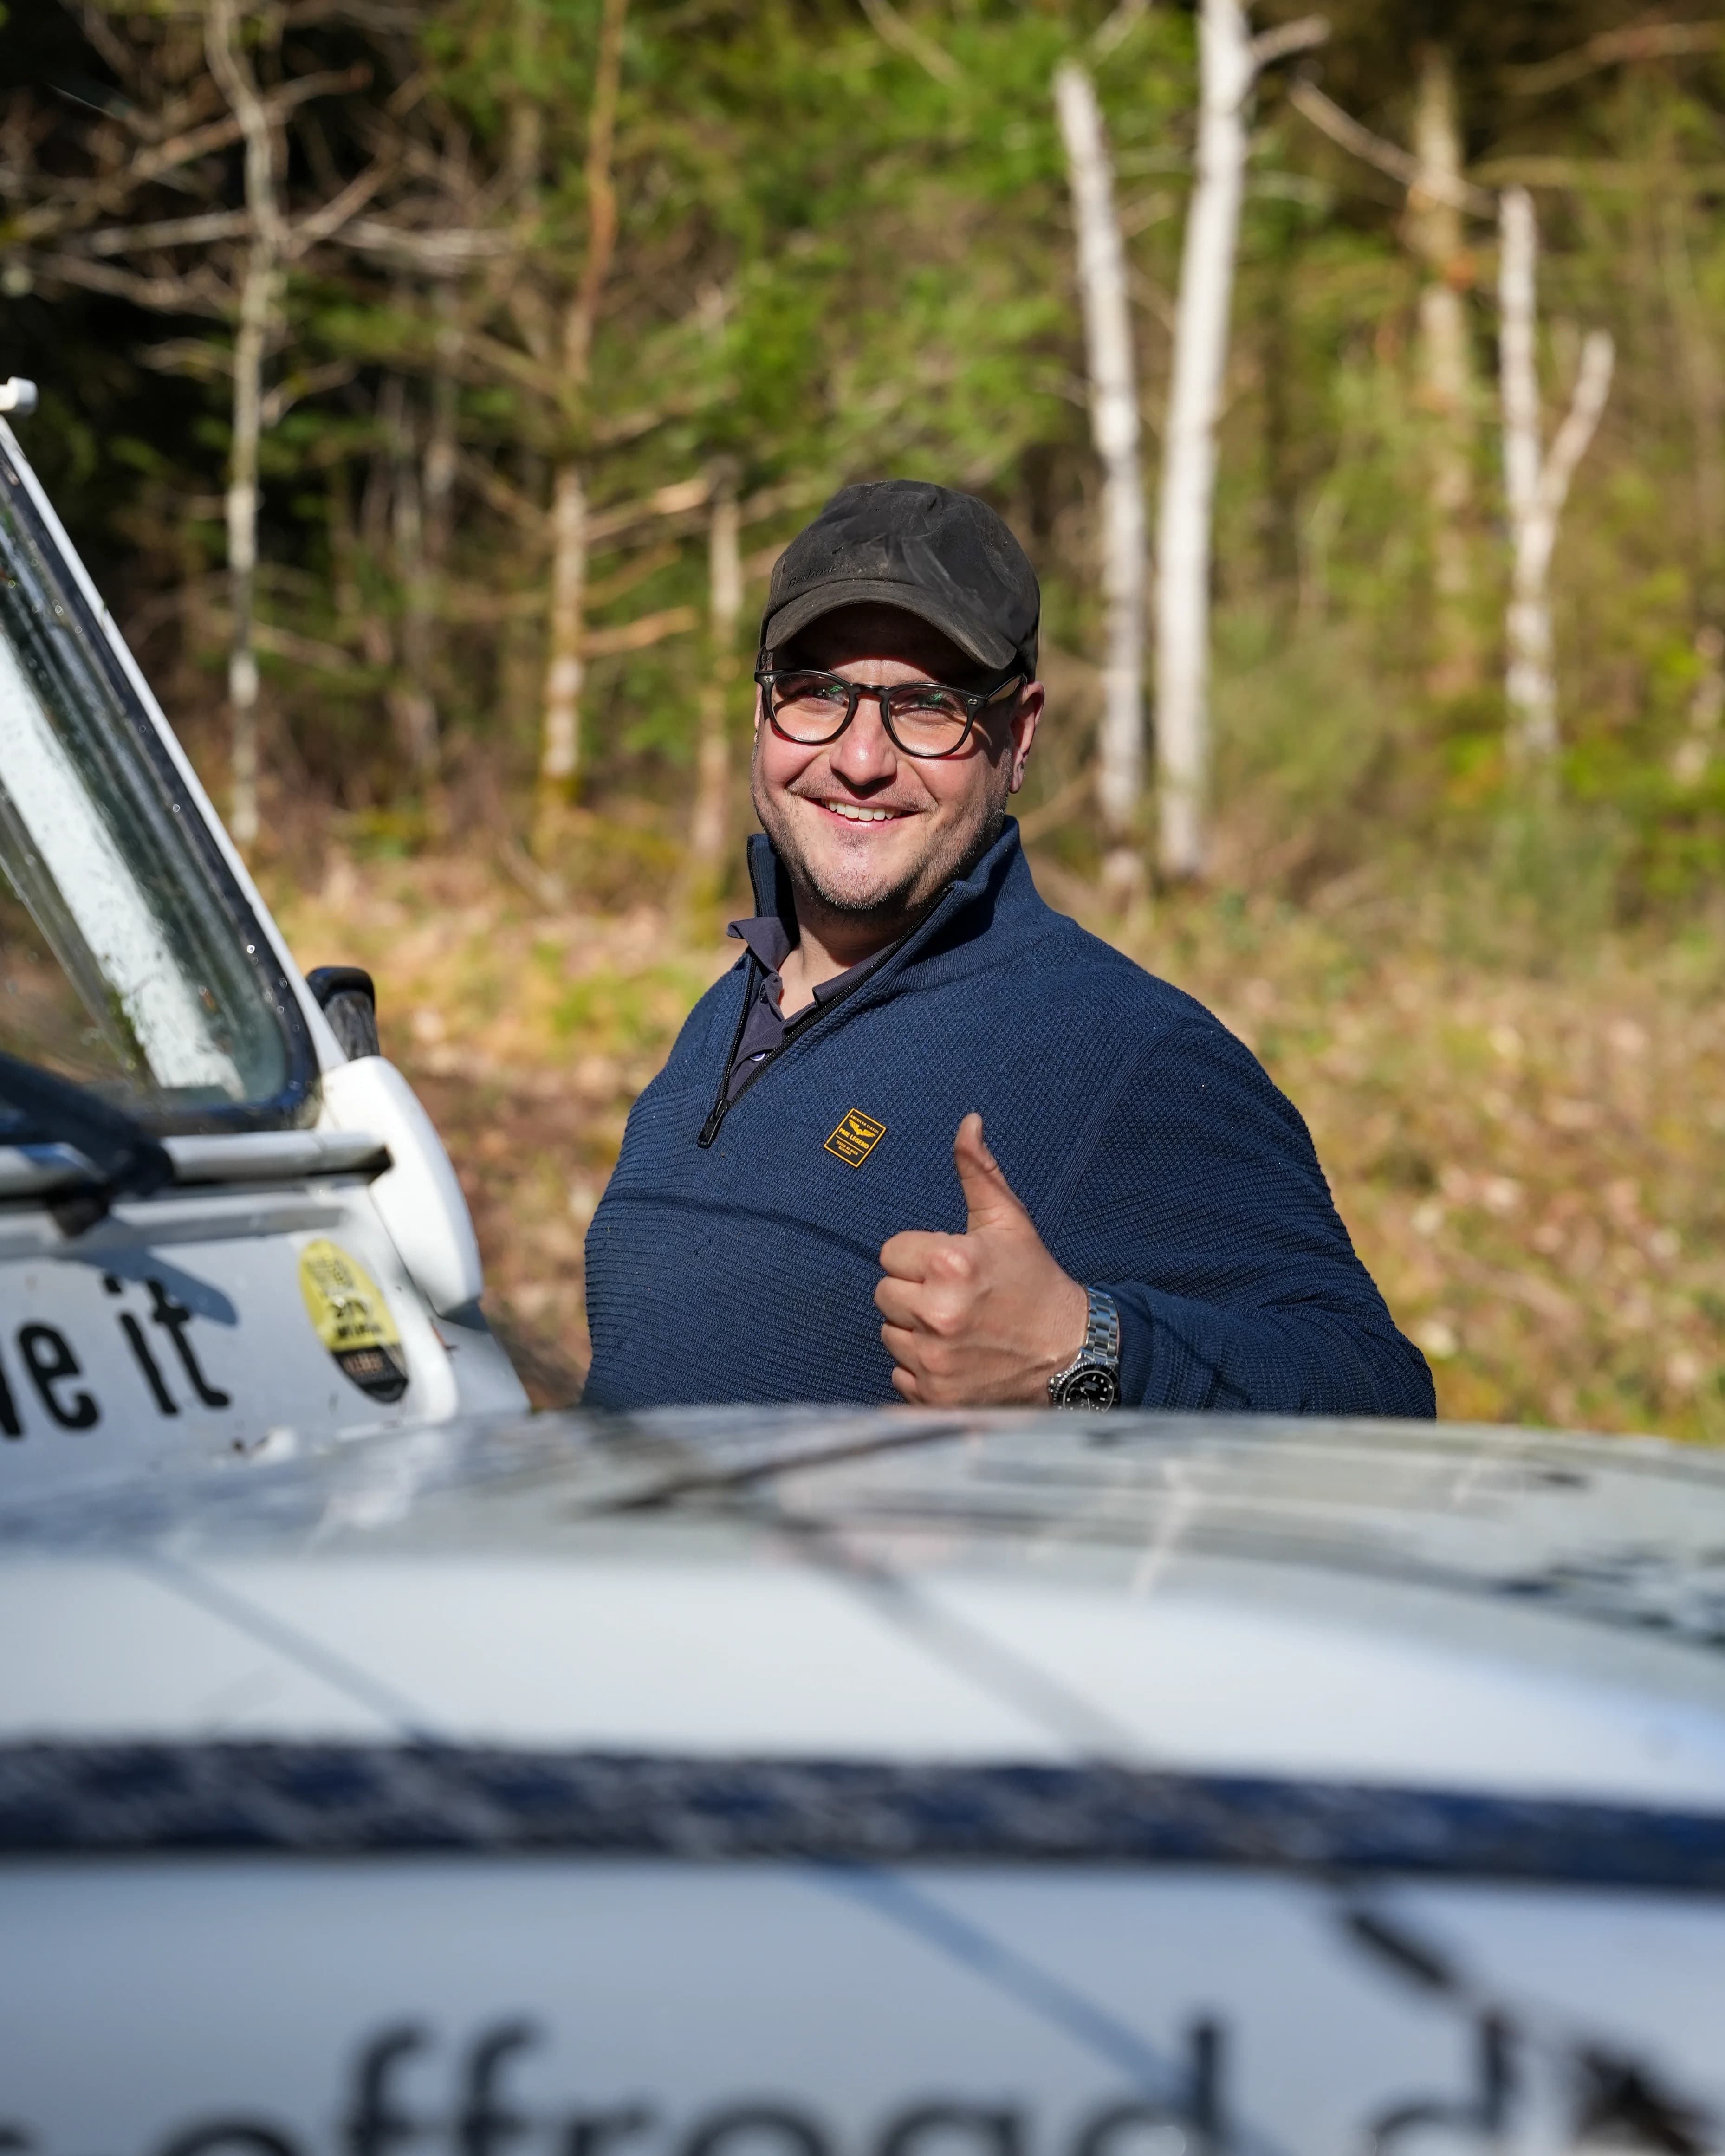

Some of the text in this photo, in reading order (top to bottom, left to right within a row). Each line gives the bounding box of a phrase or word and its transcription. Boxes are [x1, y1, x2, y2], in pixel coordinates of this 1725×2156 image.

[787, 564, 836, 589] Barbour
[838, 1127, 869, 1149] PME LEGEND
[103, 1274, 230, 1417] it
